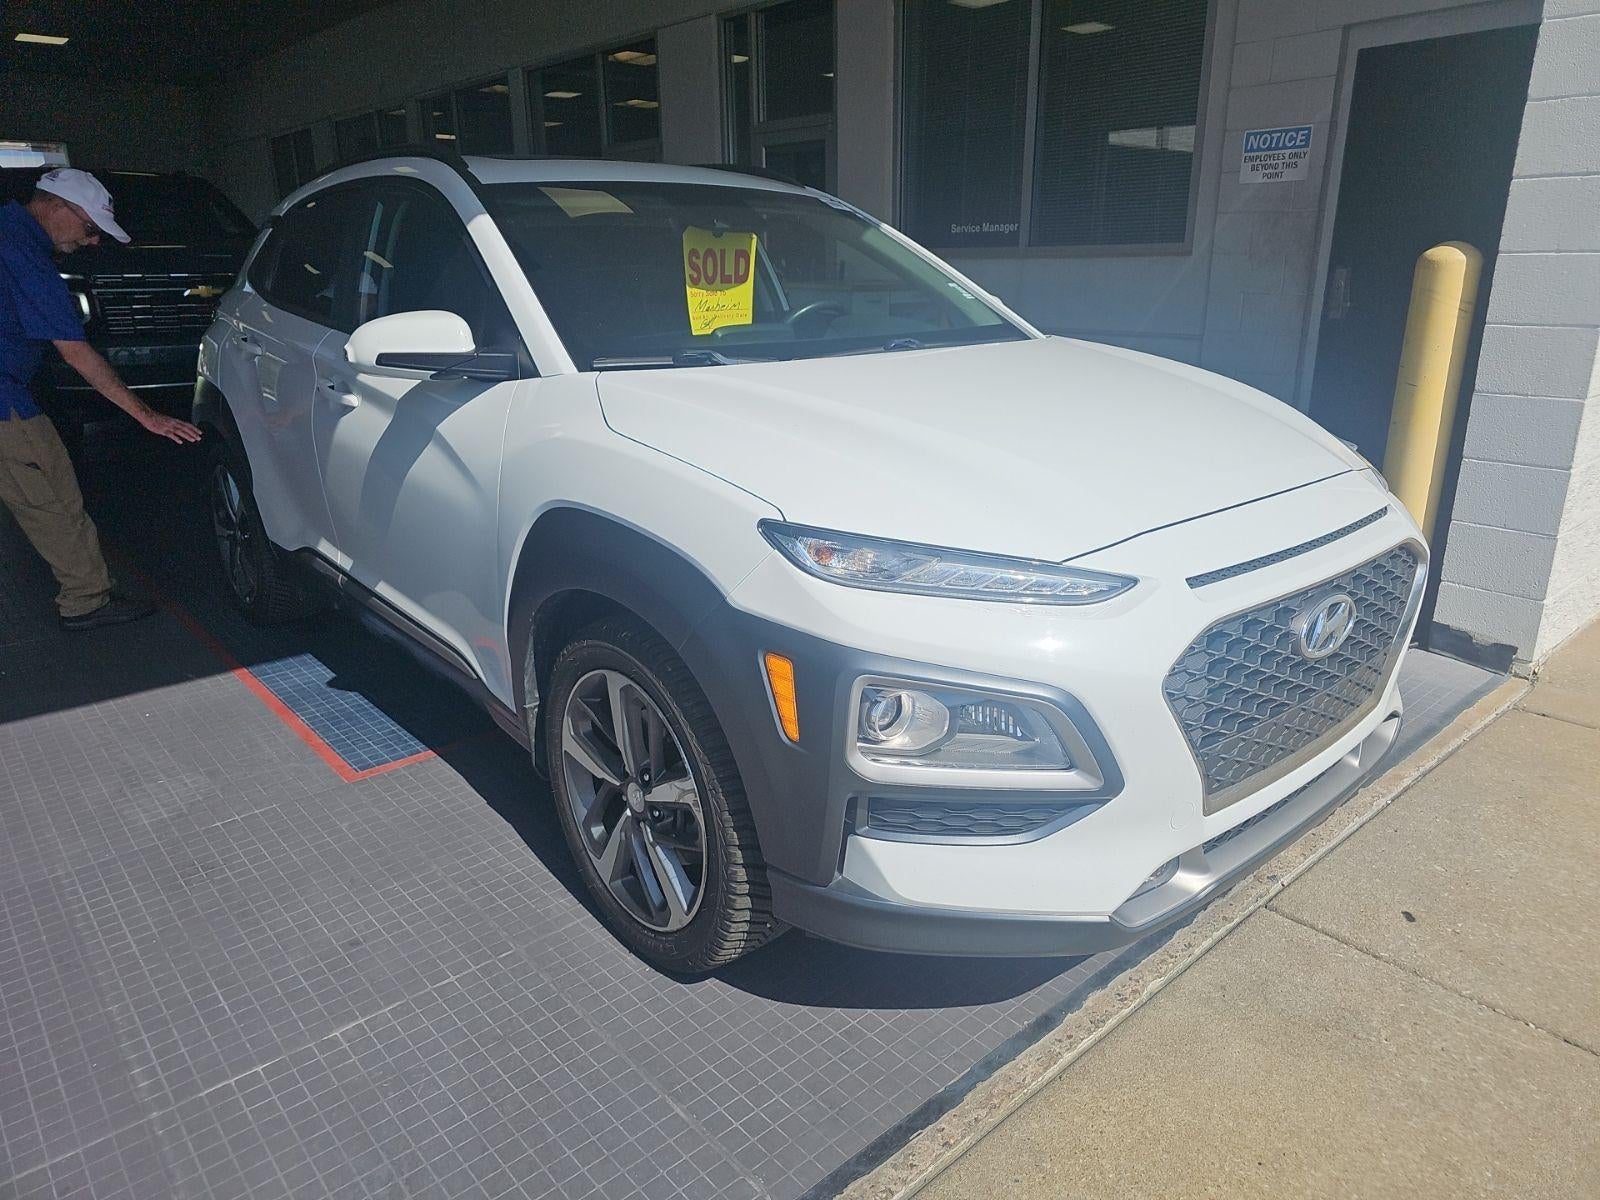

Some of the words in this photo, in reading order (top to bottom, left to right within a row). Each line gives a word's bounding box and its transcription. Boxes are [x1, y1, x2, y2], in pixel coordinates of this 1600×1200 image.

[1247, 130, 1308, 149] NOTICE
[1244, 153, 1286, 163] EMPLOYEES
[1288, 151, 1308, 160] ONLY
[1250, 162, 1279, 172] BEYOND
[1282, 161, 1298, 170] THIS
[1262, 171, 1284, 180] POINT
[951, 223, 980, 233] Service
[982, 222, 1018, 233] Manager
[688, 248, 750, 285] SOLD
